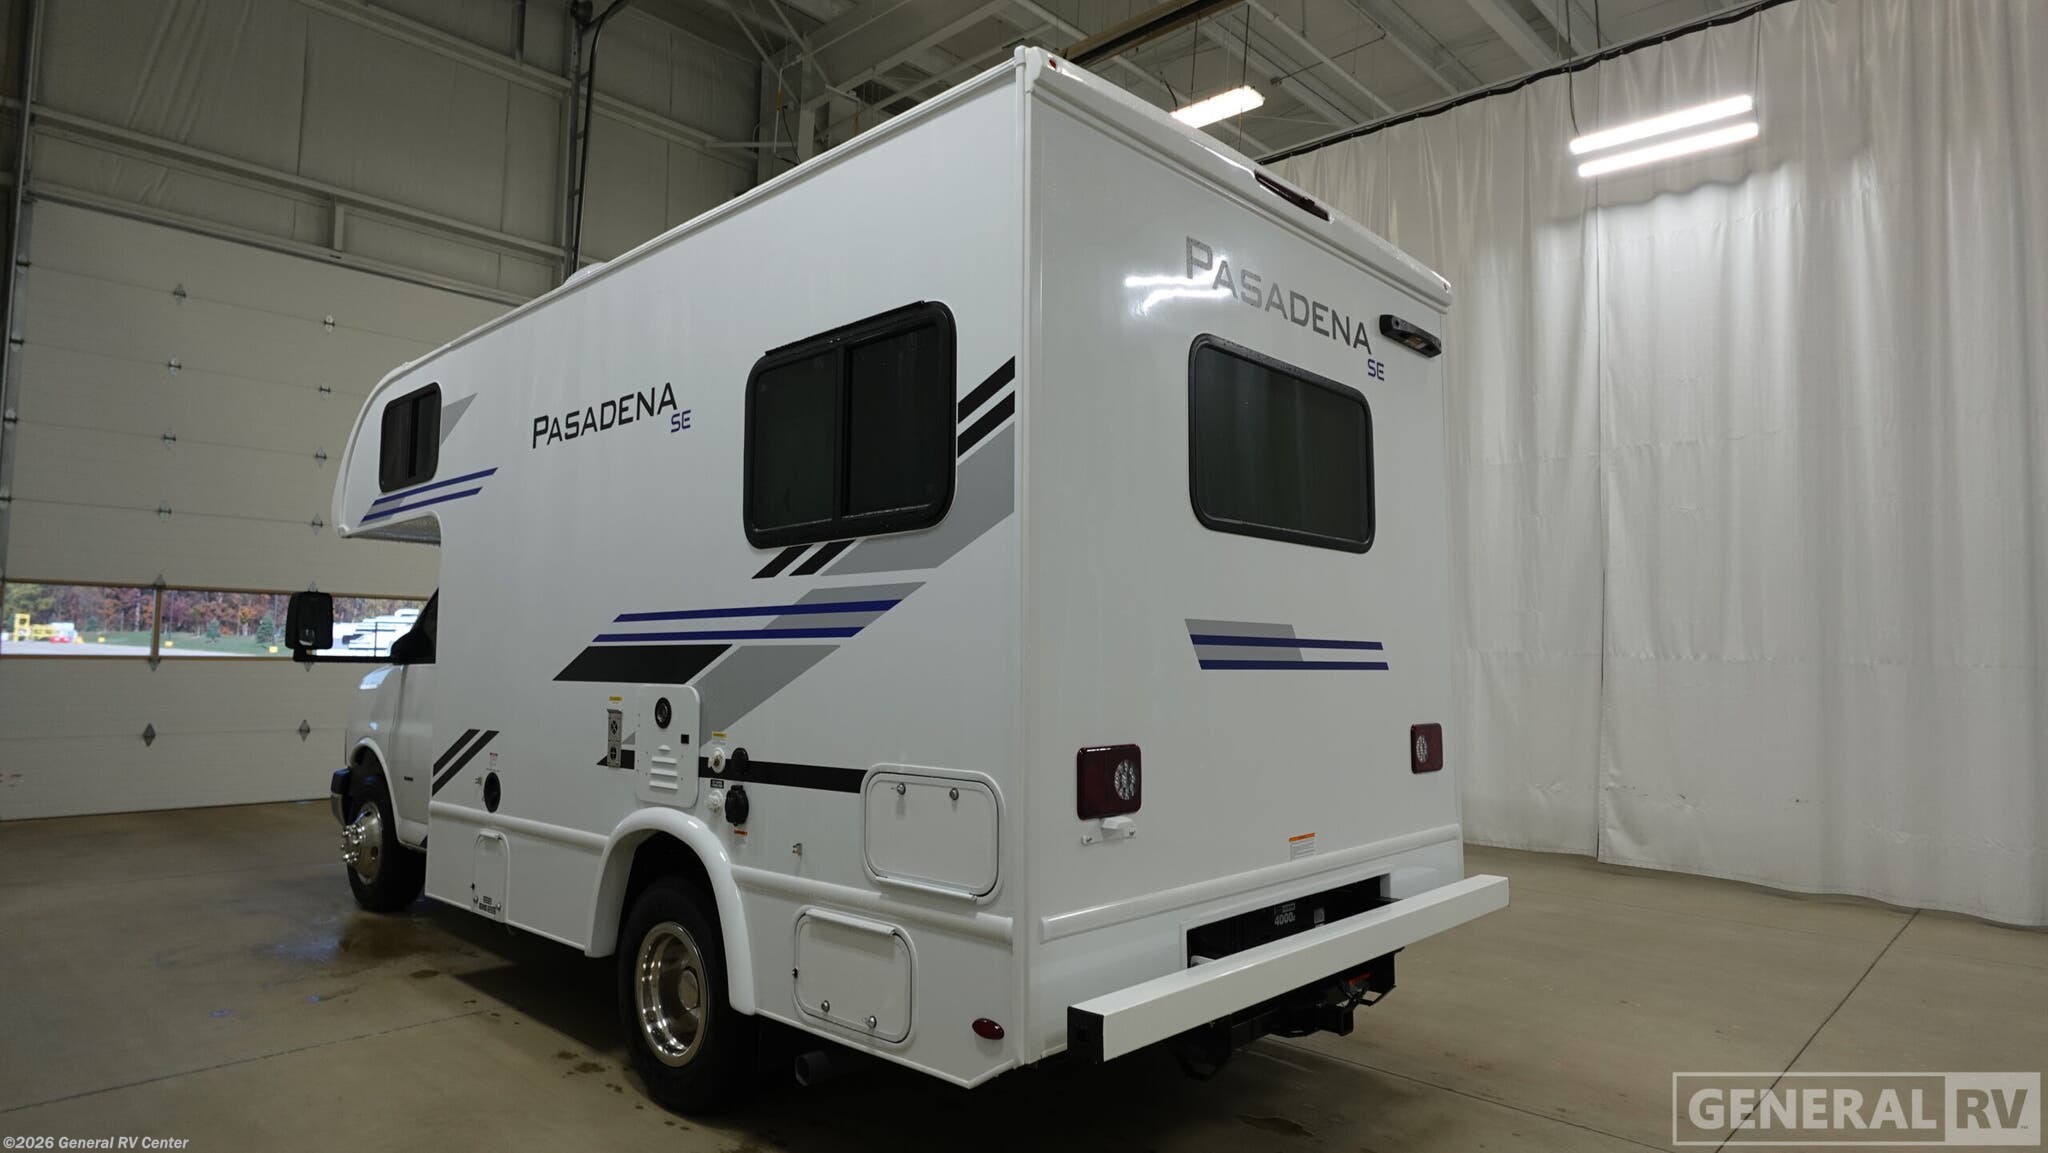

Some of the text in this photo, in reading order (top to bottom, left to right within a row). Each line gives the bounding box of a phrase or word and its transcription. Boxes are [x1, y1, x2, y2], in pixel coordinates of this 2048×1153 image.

[1186, 235, 1372, 355] PASADENA
[1367, 358, 1385, 381] SE
[532, 382, 678, 449] PASADENA
[670, 409, 692, 433] SE
